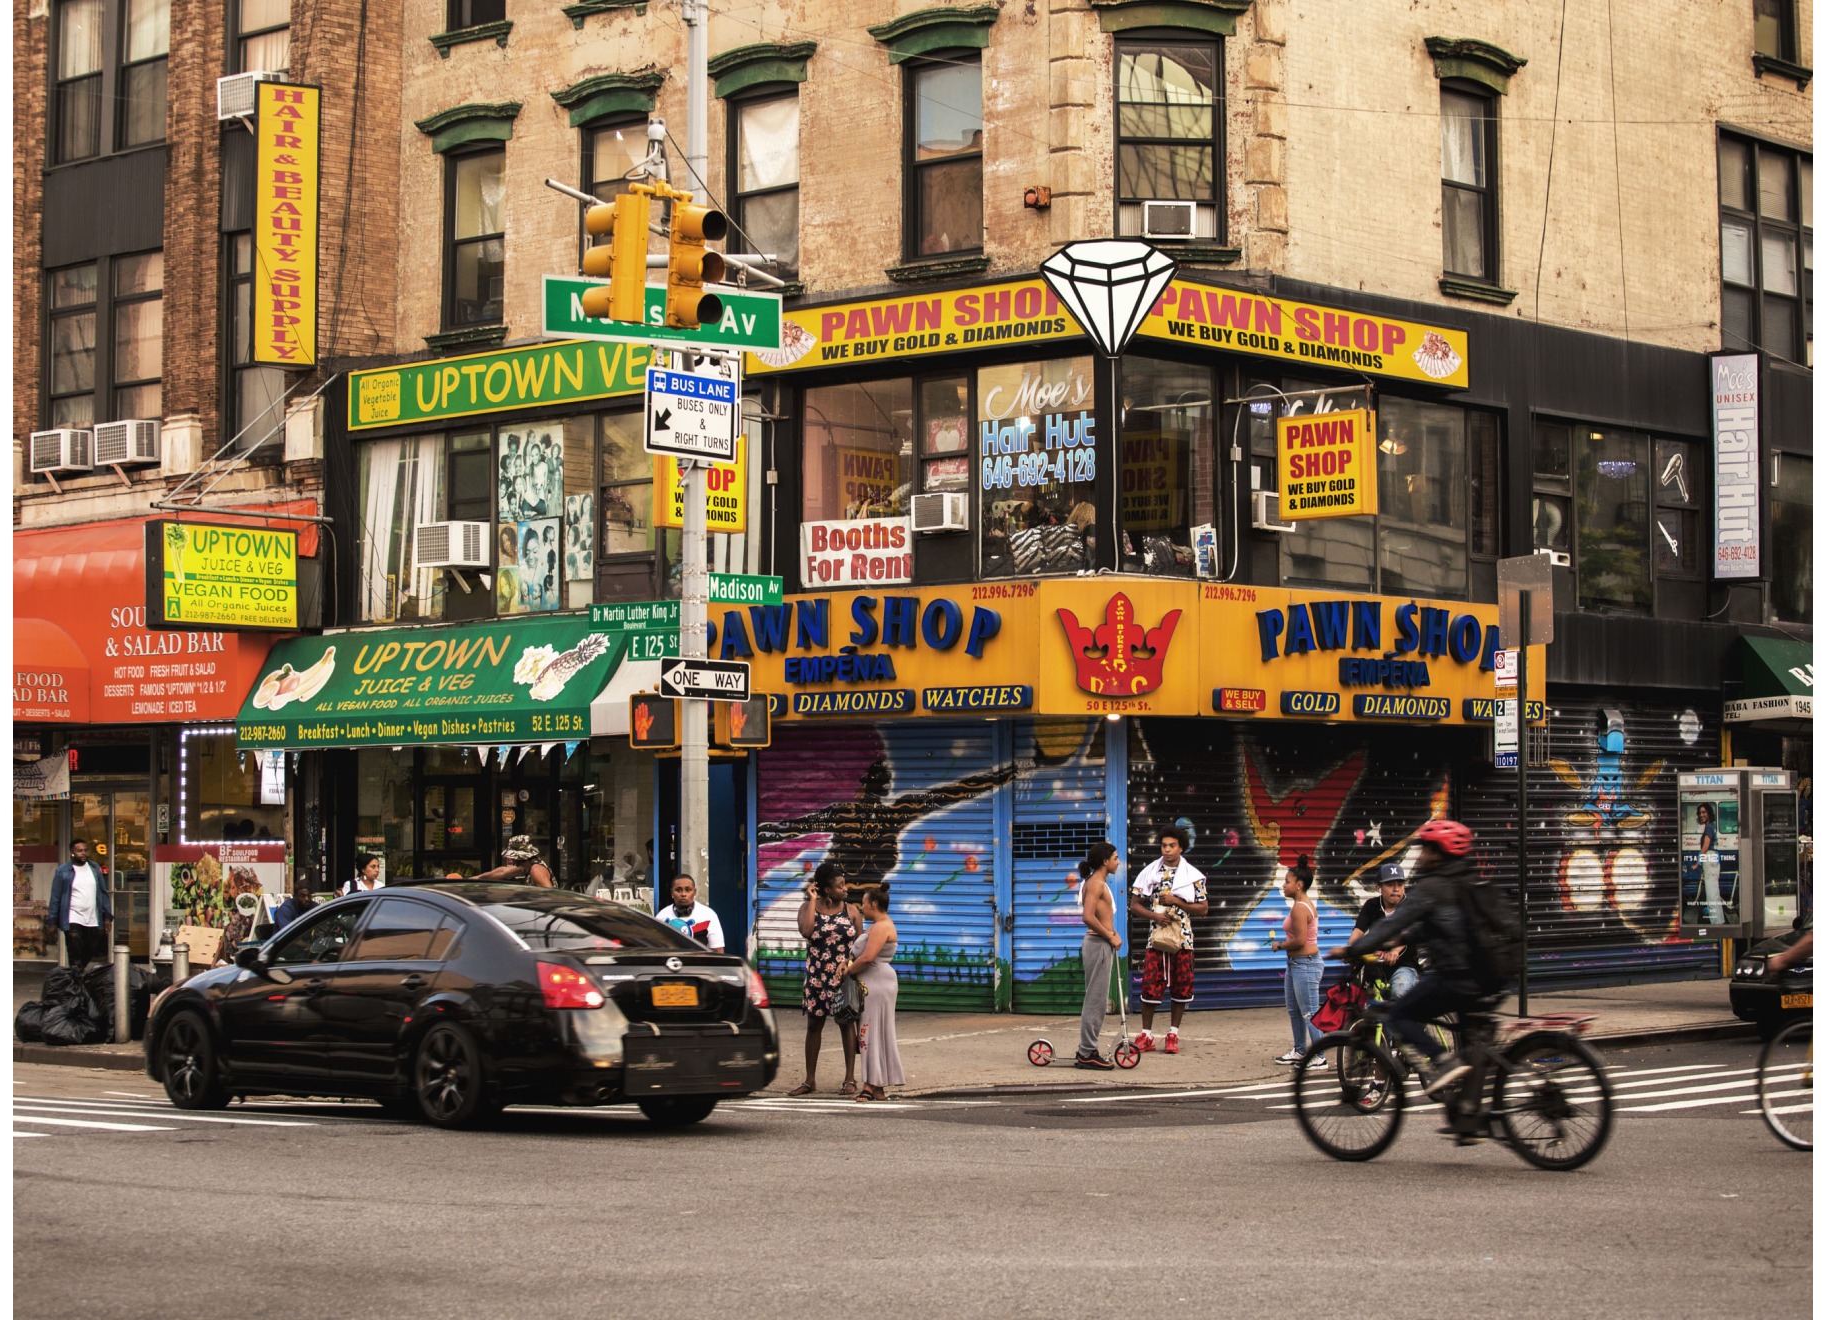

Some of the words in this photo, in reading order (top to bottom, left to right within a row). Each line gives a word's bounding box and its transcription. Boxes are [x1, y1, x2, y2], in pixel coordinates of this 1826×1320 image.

[719, 305, 756, 336] Av
[821, 298, 943, 344] PAWN
[1294, 306, 1406, 355] SHOP
[893, 333, 941, 353] GOLD
[971, 317, 1066, 344] DIAMONDS
[1237, 331, 1280, 351] GOLD
[1299, 343, 1383, 369] DIAMONDS
[415, 345, 584, 413] UPTOWN
[671, 377, 695, 393] BUS
[699, 382, 731, 399] LANE
[1716, 392, 1755, 404] UNISEX
[699, 418, 706, 430] &
[1286, 418, 1354, 450] PAWN
[982, 447, 1096, 490] 646-692-4128
[1289, 449, 1352, 479] SHOP
[1306, 480, 1327, 494] BUY
[1329, 478, 1355, 492] GOLD
[1288, 498, 1298, 510] &
[1300, 492, 1355, 509] DIAMONDS
[193, 529, 291, 559] UPTOWN
[810, 521, 906, 553] Booths
[246, 560, 254, 573] &
[807, 555, 846, 584] For
[172, 582, 233, 599] VEGAN
[240, 586, 289, 602] FOOD
[709, 577, 764, 601] Madison
[768, 580, 779, 594] Av
[190, 599, 203, 607] All
[207, 600, 250, 612] Organic
[254, 602, 287, 613] Juices
[593, 608, 601, 621] Dr
[184, 611, 236, 621] 212-987-2660
[240, 614, 258, 623] FREE
[259, 616, 292, 625] DELIVERY
[624, 621, 646, 630] Boulevard
[849, 595, 1002, 659] SHOP
[1255, 600, 1383, 662] PAWN
[123, 633, 182, 656] SALAD
[353, 634, 512, 676] UPTOWN
[632, 642, 639, 657] E
[669, 635, 678, 649] St
[354, 677, 416, 696] JUICE
[437, 673, 476, 692] VEG
[1225, 688, 1241, 699] WE
[1241, 690, 1261, 700] BUY
[315, 701, 334, 712] ALL
[402, 696, 422, 708] ALL
[473, 693, 514, 705] JUICES
[797, 690, 905, 713] DIAMONDS
[926, 686, 1024, 709] WATCHES
[1086, 701, 1100, 711] 50
[1234, 699, 1260, 710] SELL
[1291, 692, 1338, 713] GOLD
[1363, 696, 1448, 717] DIAMONDS
[1752, 698, 1789, 710] FASHION
[1724, 711, 1741, 720] TEL:
[298, 723, 339, 740] Breakfast
[478, 717, 516, 734] Pastries
[532, 716, 542, 731] 52
[1496, 756, 1518, 767] 110197
[1695, 775, 1723, 785] TITAN
[1761, 775, 1779, 785] TITAN
